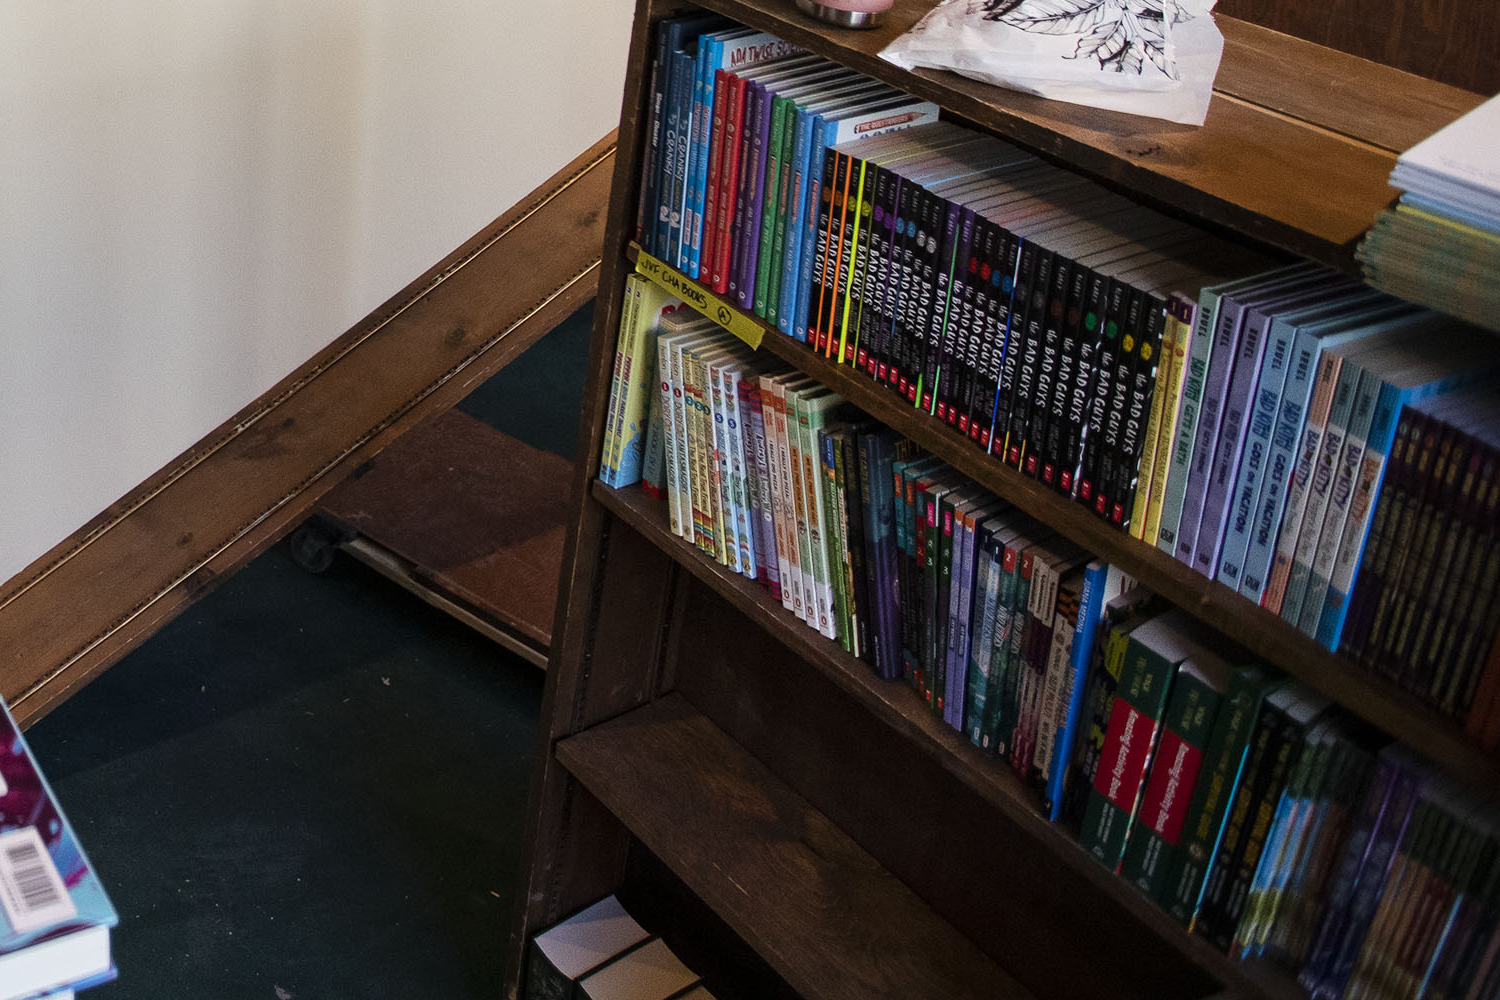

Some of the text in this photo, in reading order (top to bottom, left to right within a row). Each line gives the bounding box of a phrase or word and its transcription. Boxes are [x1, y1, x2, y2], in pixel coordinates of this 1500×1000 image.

[731, 42, 775, 68] ADA TWIST
[662, 129, 676, 176] CRANKY
[675, 135, 687, 181] CRANKY
[813, 214, 828, 284] the BAD GUYS
[841, 239, 852, 262] BAD
[852, 228, 868, 300] the BAD GUYS
[864, 233, 880, 306] the BAD GUYS
[681, 283, 708, 309] BOOKS
[838, 264, 848, 295] GUYS
[884, 245, 902, 318] the BAD GUYS
[914, 265, 932, 340] the BAD GUYS
[930, 272, 948, 347] the BAD GUYS
[944, 280, 963, 354] the BAD GUYS
[966, 292, 986, 368] the BAD GUYS
[988, 305, 1009, 382] the BAD GUYS
[1002, 313, 1022, 390] the BAD GUYS
[1035, 329, 1058, 408] the BAD GUYS
[1188, 356, 1206, 377] BAD
[1070, 343, 1092, 423] the BAD GUYS
[1090, 352, 1114, 432] the BAD GUYS
[1106, 364, 1129, 446] the BAD GUYS
[1184, 376, 1202, 402] KITTY
[1257, 388, 1277, 412] BAD
[1280, 400, 1301, 423] BAD
[662, 395, 676, 488] DORY FANTASMAGORY
[1122, 373, 1148, 454] the BAD GUYS
[1180, 429, 1190, 438] A
[1181, 404, 1194, 428] GETS
[1251, 409, 1273, 439] KITTY
[1274, 421, 1297, 451] KITTY
[674, 401, 688, 494] DORY FANTASMAGORY
[1174, 439, 1188, 465] BATH
[1247, 441, 1263, 467] GOES
[1270, 453, 1287, 481] GOES
[1293, 429, 1320, 491] BAD KITTY
[1311, 431, 1342, 497] BAD KITTY
[701, 490, 710, 513] Friend
[734, 490, 745, 508] Tough
[1331, 444, 1361, 511] BAD KITTY
[1233, 485, 1254, 534] VACATION
[1255, 497, 1276, 546] VACATION
[1074, 577, 1091, 633] JUANA MEDINA
[1107, 708, 1139, 801] Amazing Activity Book
[1154, 740, 1189, 833] Amazing Activity Book
